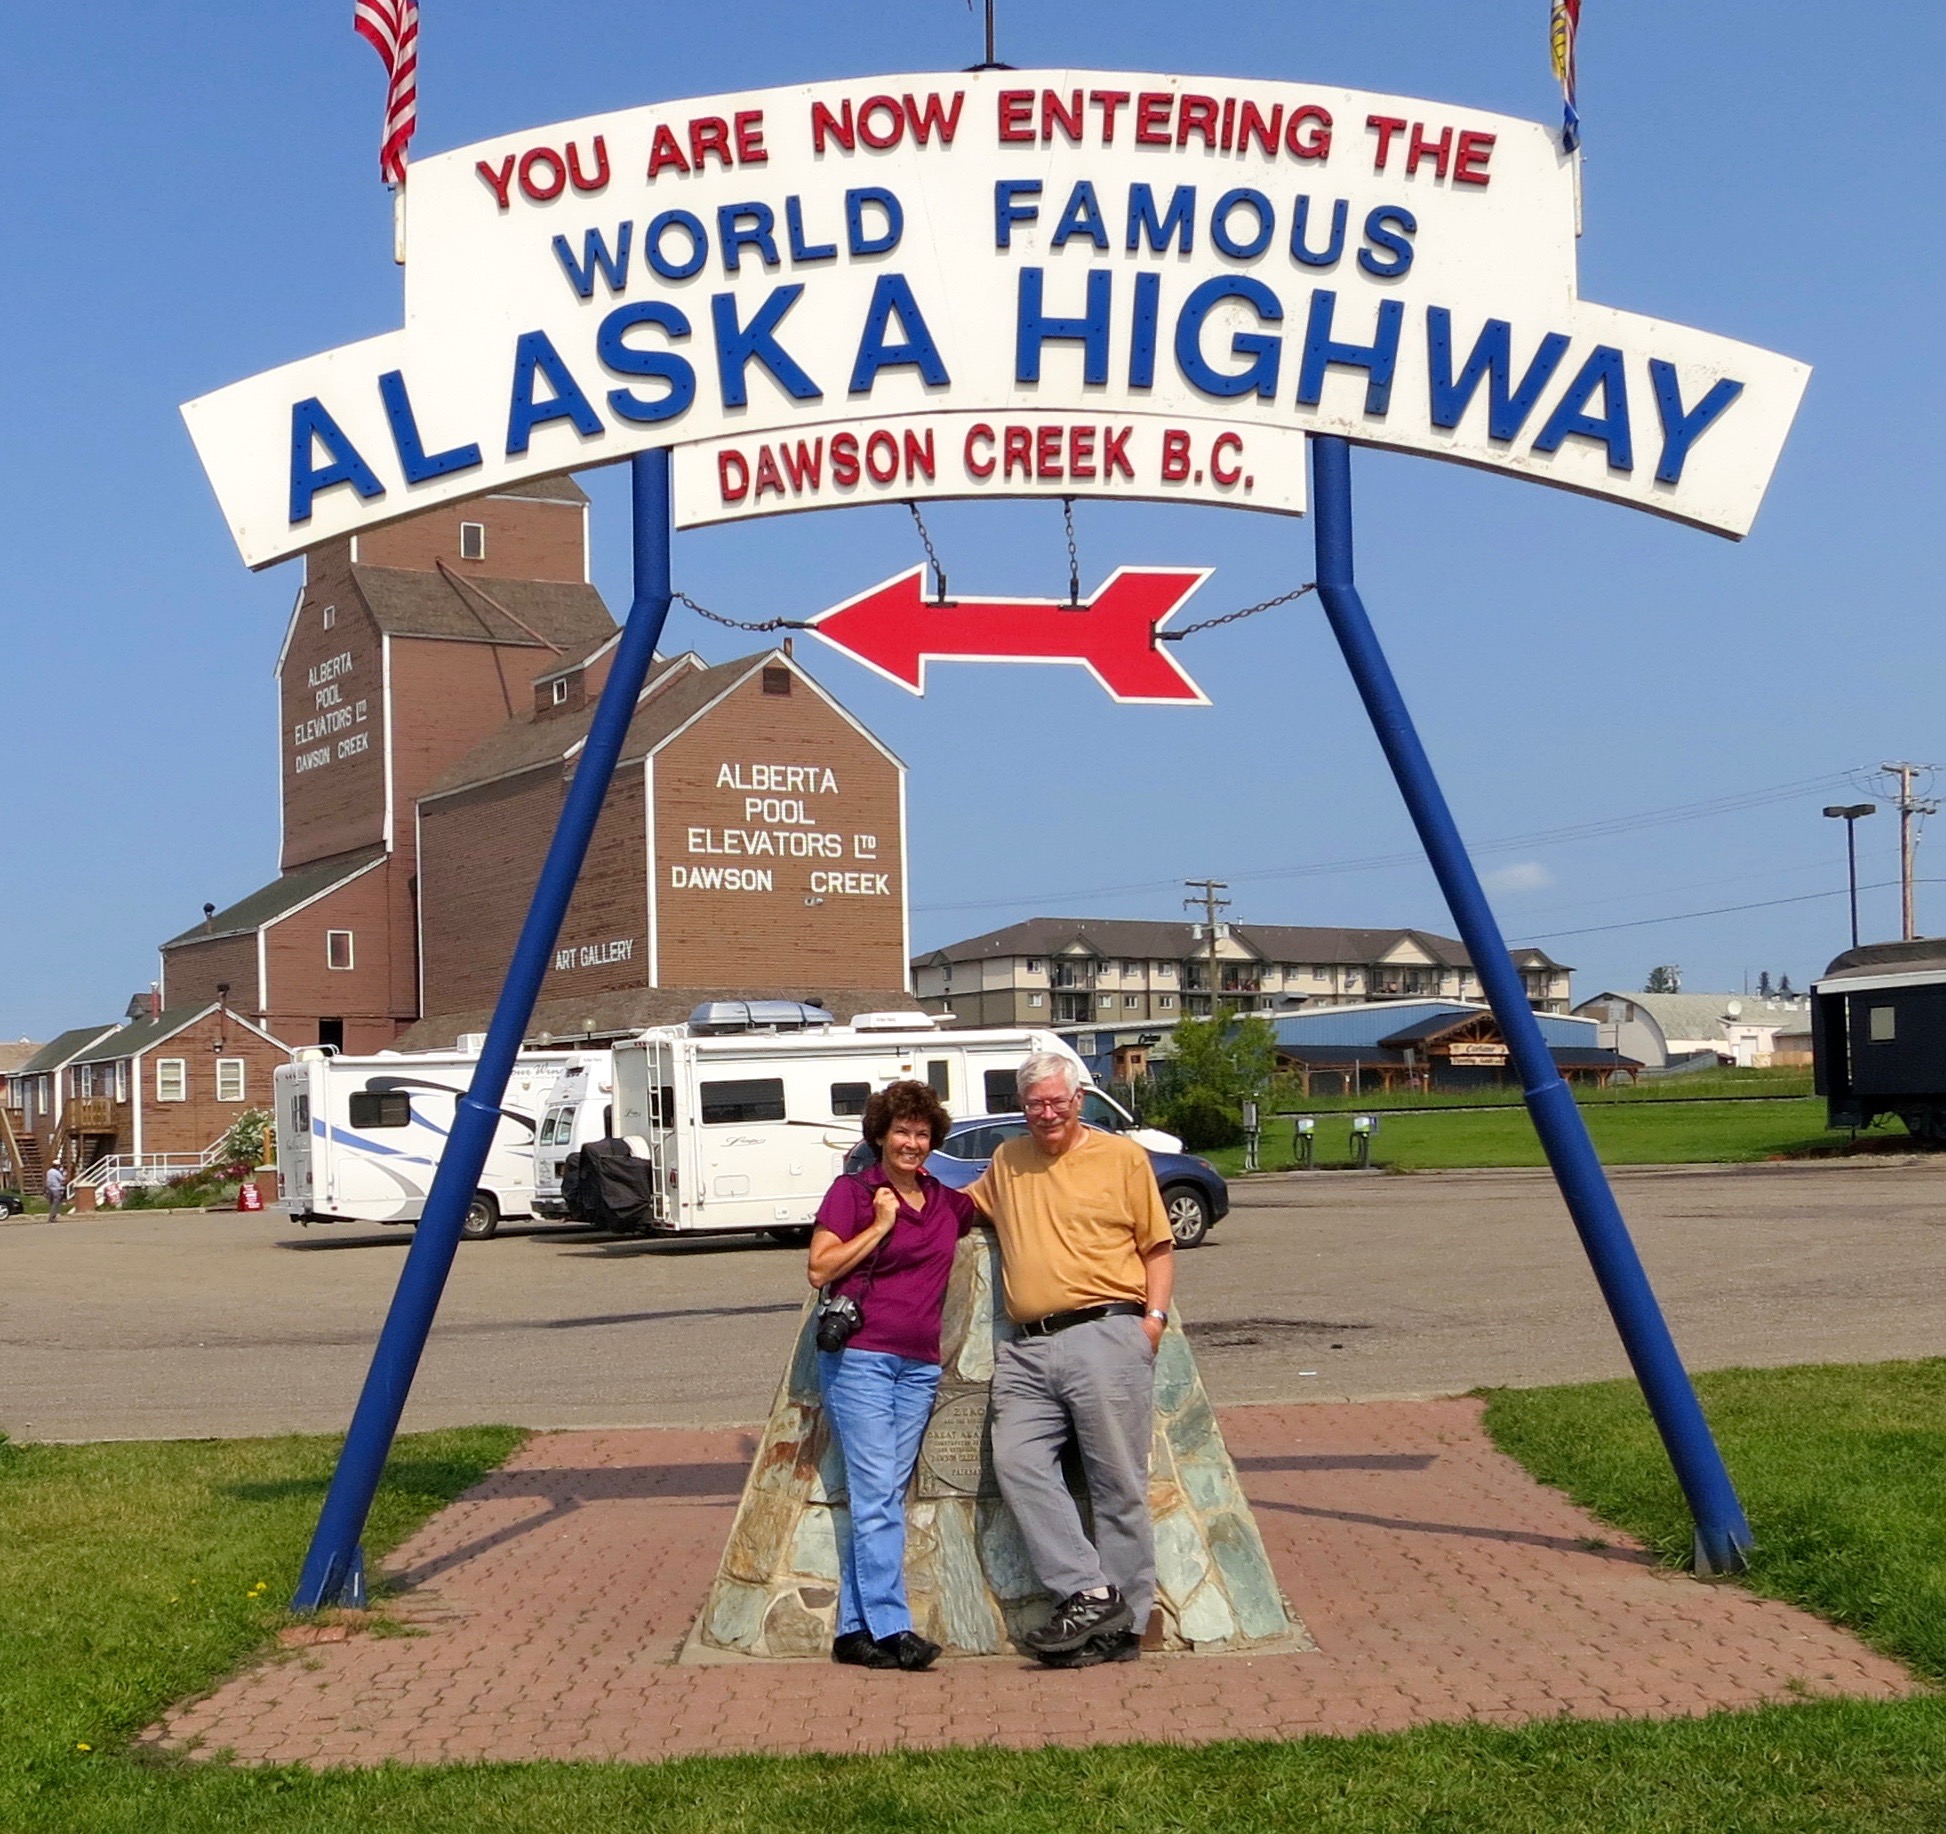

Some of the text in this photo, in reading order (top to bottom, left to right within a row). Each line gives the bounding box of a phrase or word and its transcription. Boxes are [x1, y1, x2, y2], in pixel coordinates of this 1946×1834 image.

[476, 89, 1497, 208] YOU ARE NOW ENTERING THE
[552, 179, 1418, 298] WORLD FAMOUS
[289, 267, 1745, 524] ALASKA HIGHWAY
[718, 424, 1254, 501] DAWSON CREEK B.C.
[307, 652, 353, 688] ALBERTA
[316, 684, 343, 711] POOL
[294, 706, 353, 745] ELEVATORS
[295, 732, 369, 774] DAWSON CREEK
[716, 763, 839, 794] ALBERTA
[745, 797, 815, 825] POOL
[687, 827, 842, 858] ELEVATORS
[671, 866, 890, 895] DAWSON CREEK
[555, 939, 634, 970] ART GALLERY
